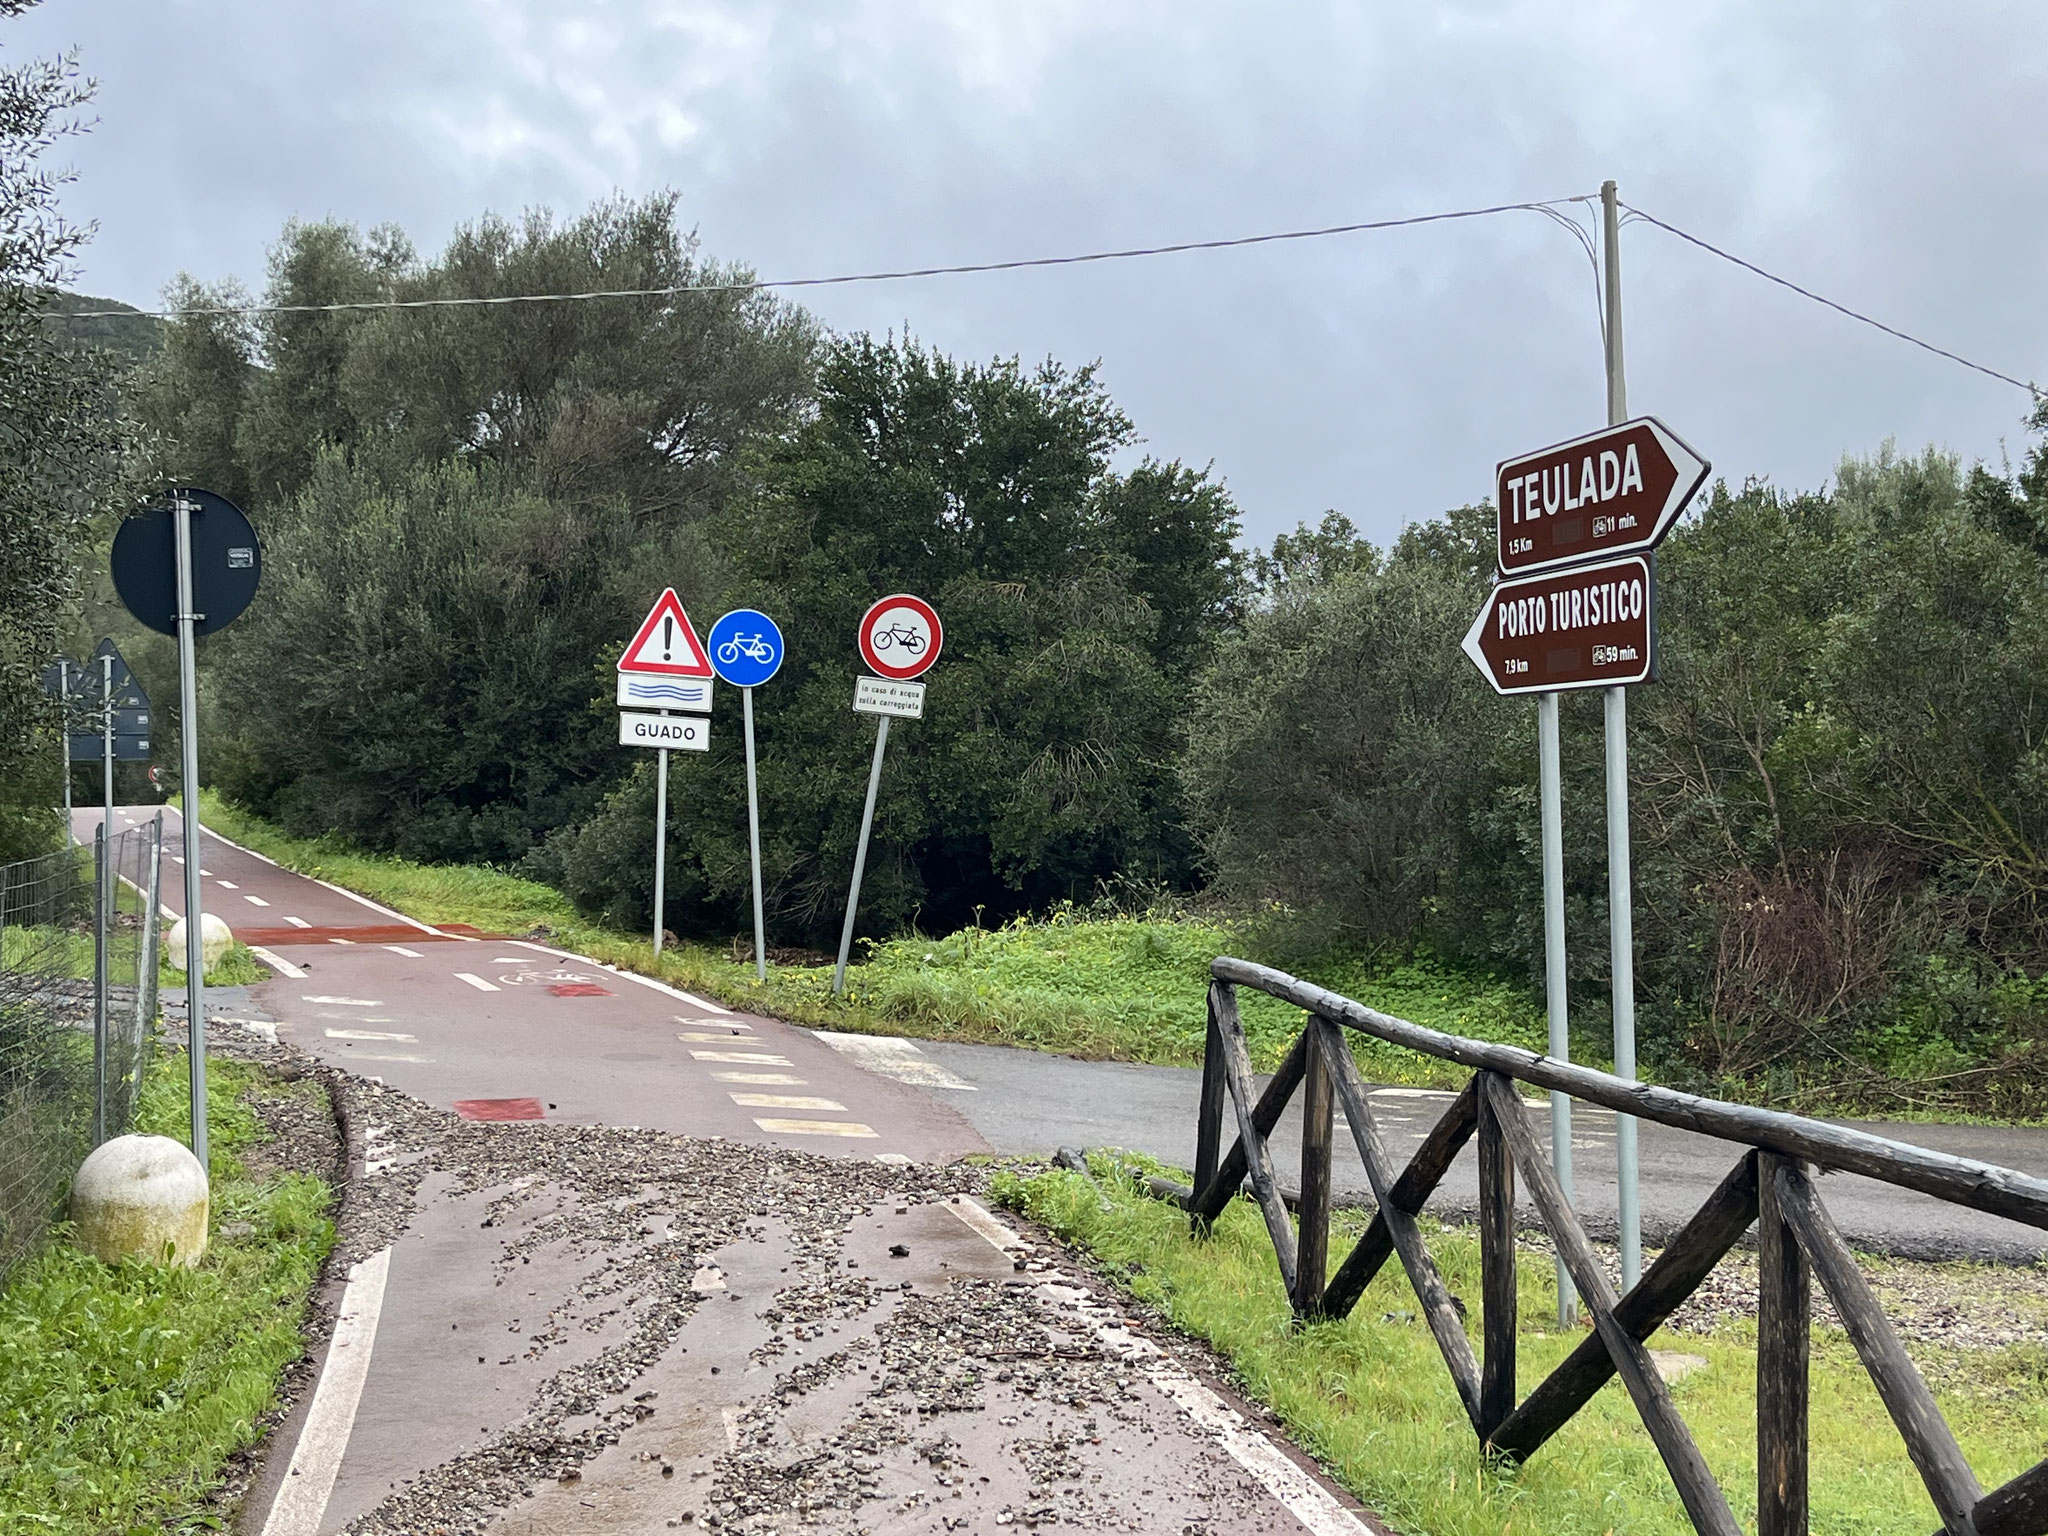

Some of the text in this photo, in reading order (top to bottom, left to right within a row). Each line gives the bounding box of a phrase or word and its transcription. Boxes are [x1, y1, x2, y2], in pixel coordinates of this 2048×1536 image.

[1507, 443, 1643, 524] TEULADA
[1607, 513, 1637, 532] 11 min.
[1508, 537, 1533, 555] 1,5 Km
[1499, 579, 1642, 639] PORTO TURISTICO
[1606, 645, 1638, 663] 59 min.
[1505, 659, 1528, 674] 7,9 km
[861, 684, 920, 699] in caso di acqua
[859, 697, 919, 710] sulla carreggiata
[635, 723, 696, 741] GUADO
